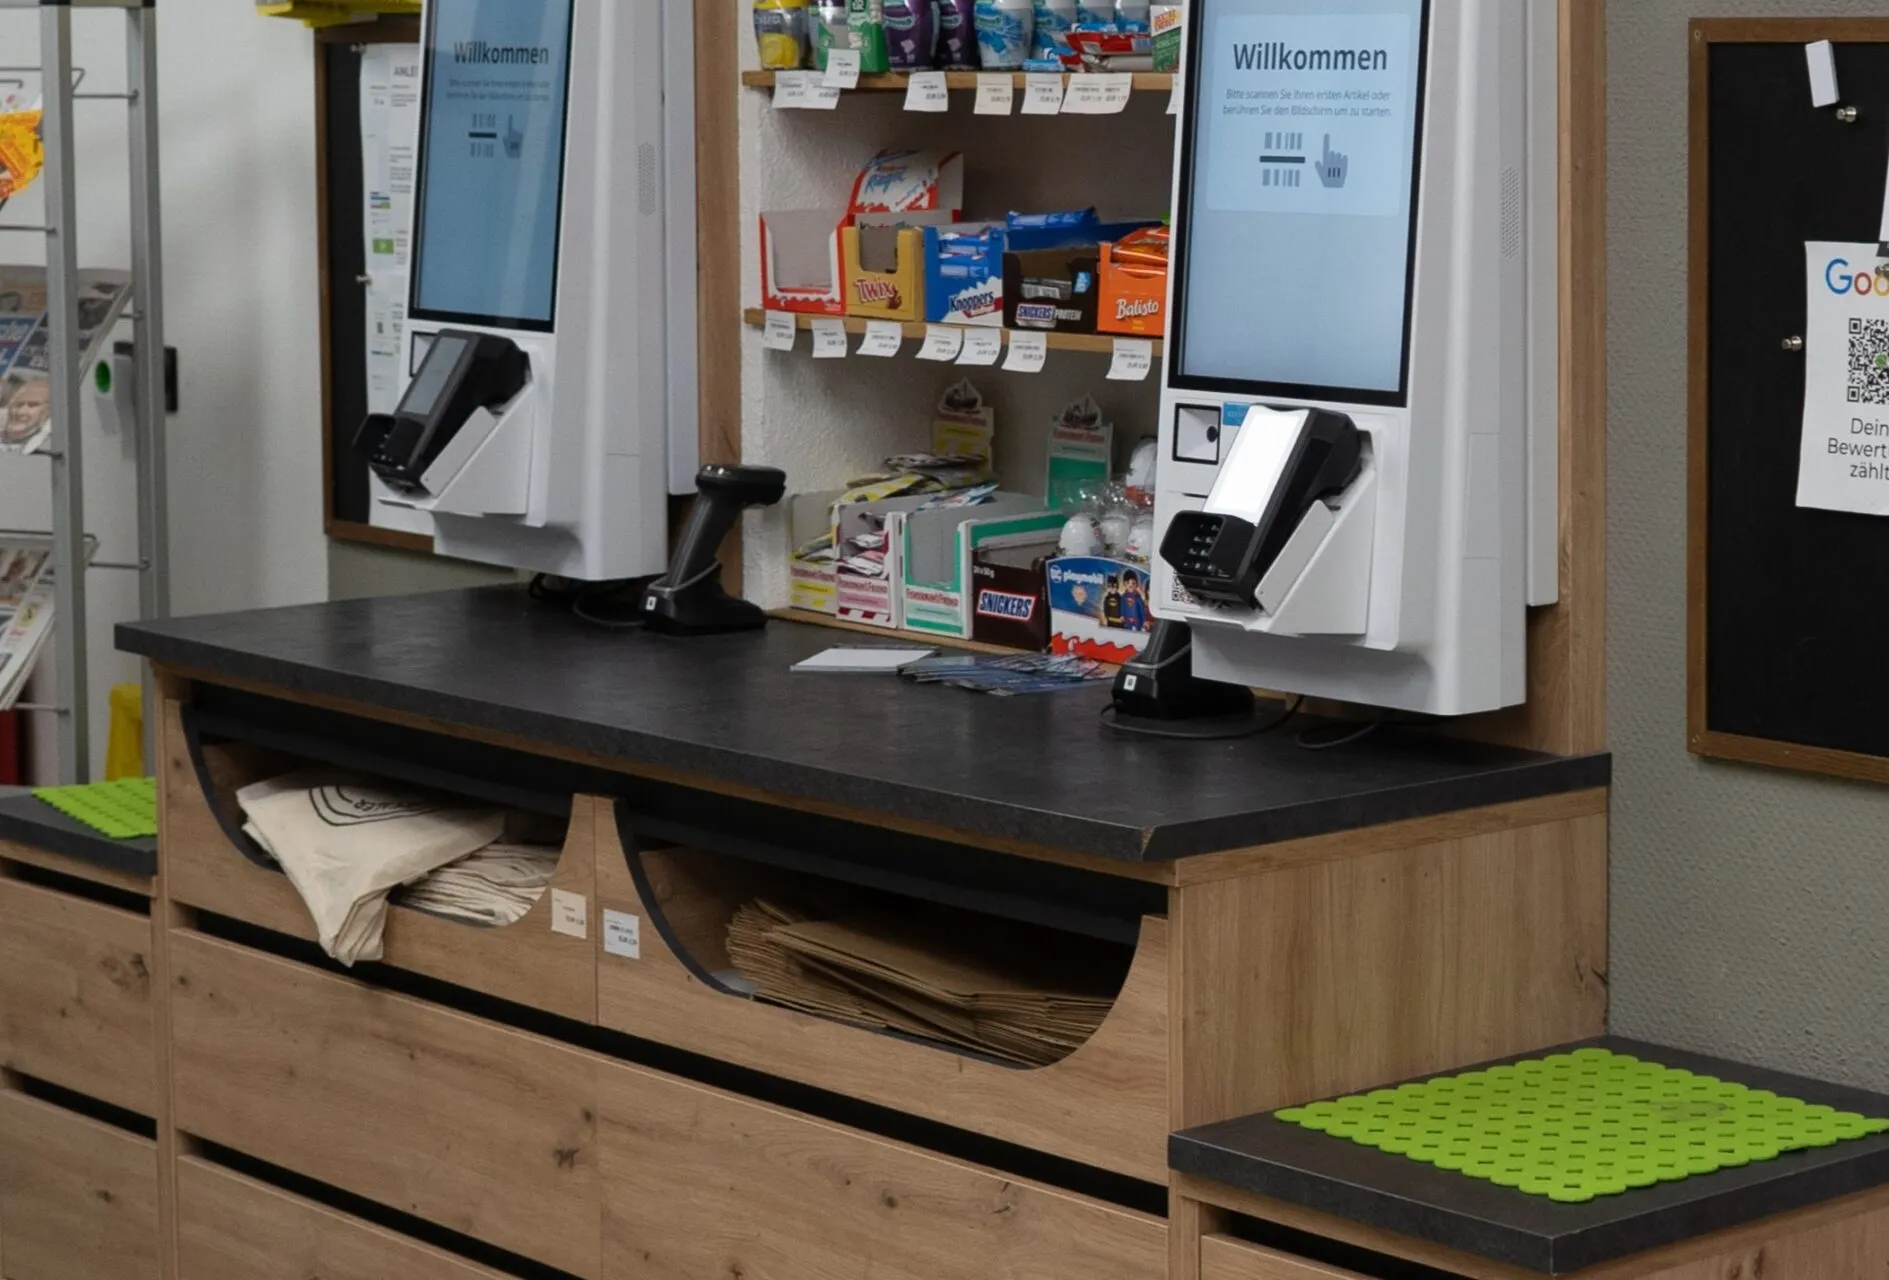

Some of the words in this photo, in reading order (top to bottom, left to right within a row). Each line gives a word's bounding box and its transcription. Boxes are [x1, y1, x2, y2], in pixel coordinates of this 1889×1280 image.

[454, 40, 549, 65] Willkommen
[1233, 42, 1387, 70] Willkommen
[1226, 89, 1244, 100] Bitte
[1246, 91, 1279, 100] scannen
[1280, 89, 1292, 100] Sie
[1293, 90, 1315, 100] Ihren
[1316, 91, 1342, 101] ersten
[1343, 89, 1370, 101] Artikel
[1371, 91, 1392, 101] oder
[1223, 105, 1259, 116] berühren
[1260, 105, 1273, 116] Sie
[1273, 105, 1289, 116] den
[1291, 105, 1333, 116] Bildschirm
[1334, 107, 1348, 116] um
[1350, 107, 1360, 116] zu
[1361, 106, 1392, 117] starten.
[950, 291, 994, 312] Knoppers
[1116, 298, 1160, 320] Balisto
[1018, 305, 1054, 320] SNICKERS
[980, 591, 1033, 618] SNICKERS
